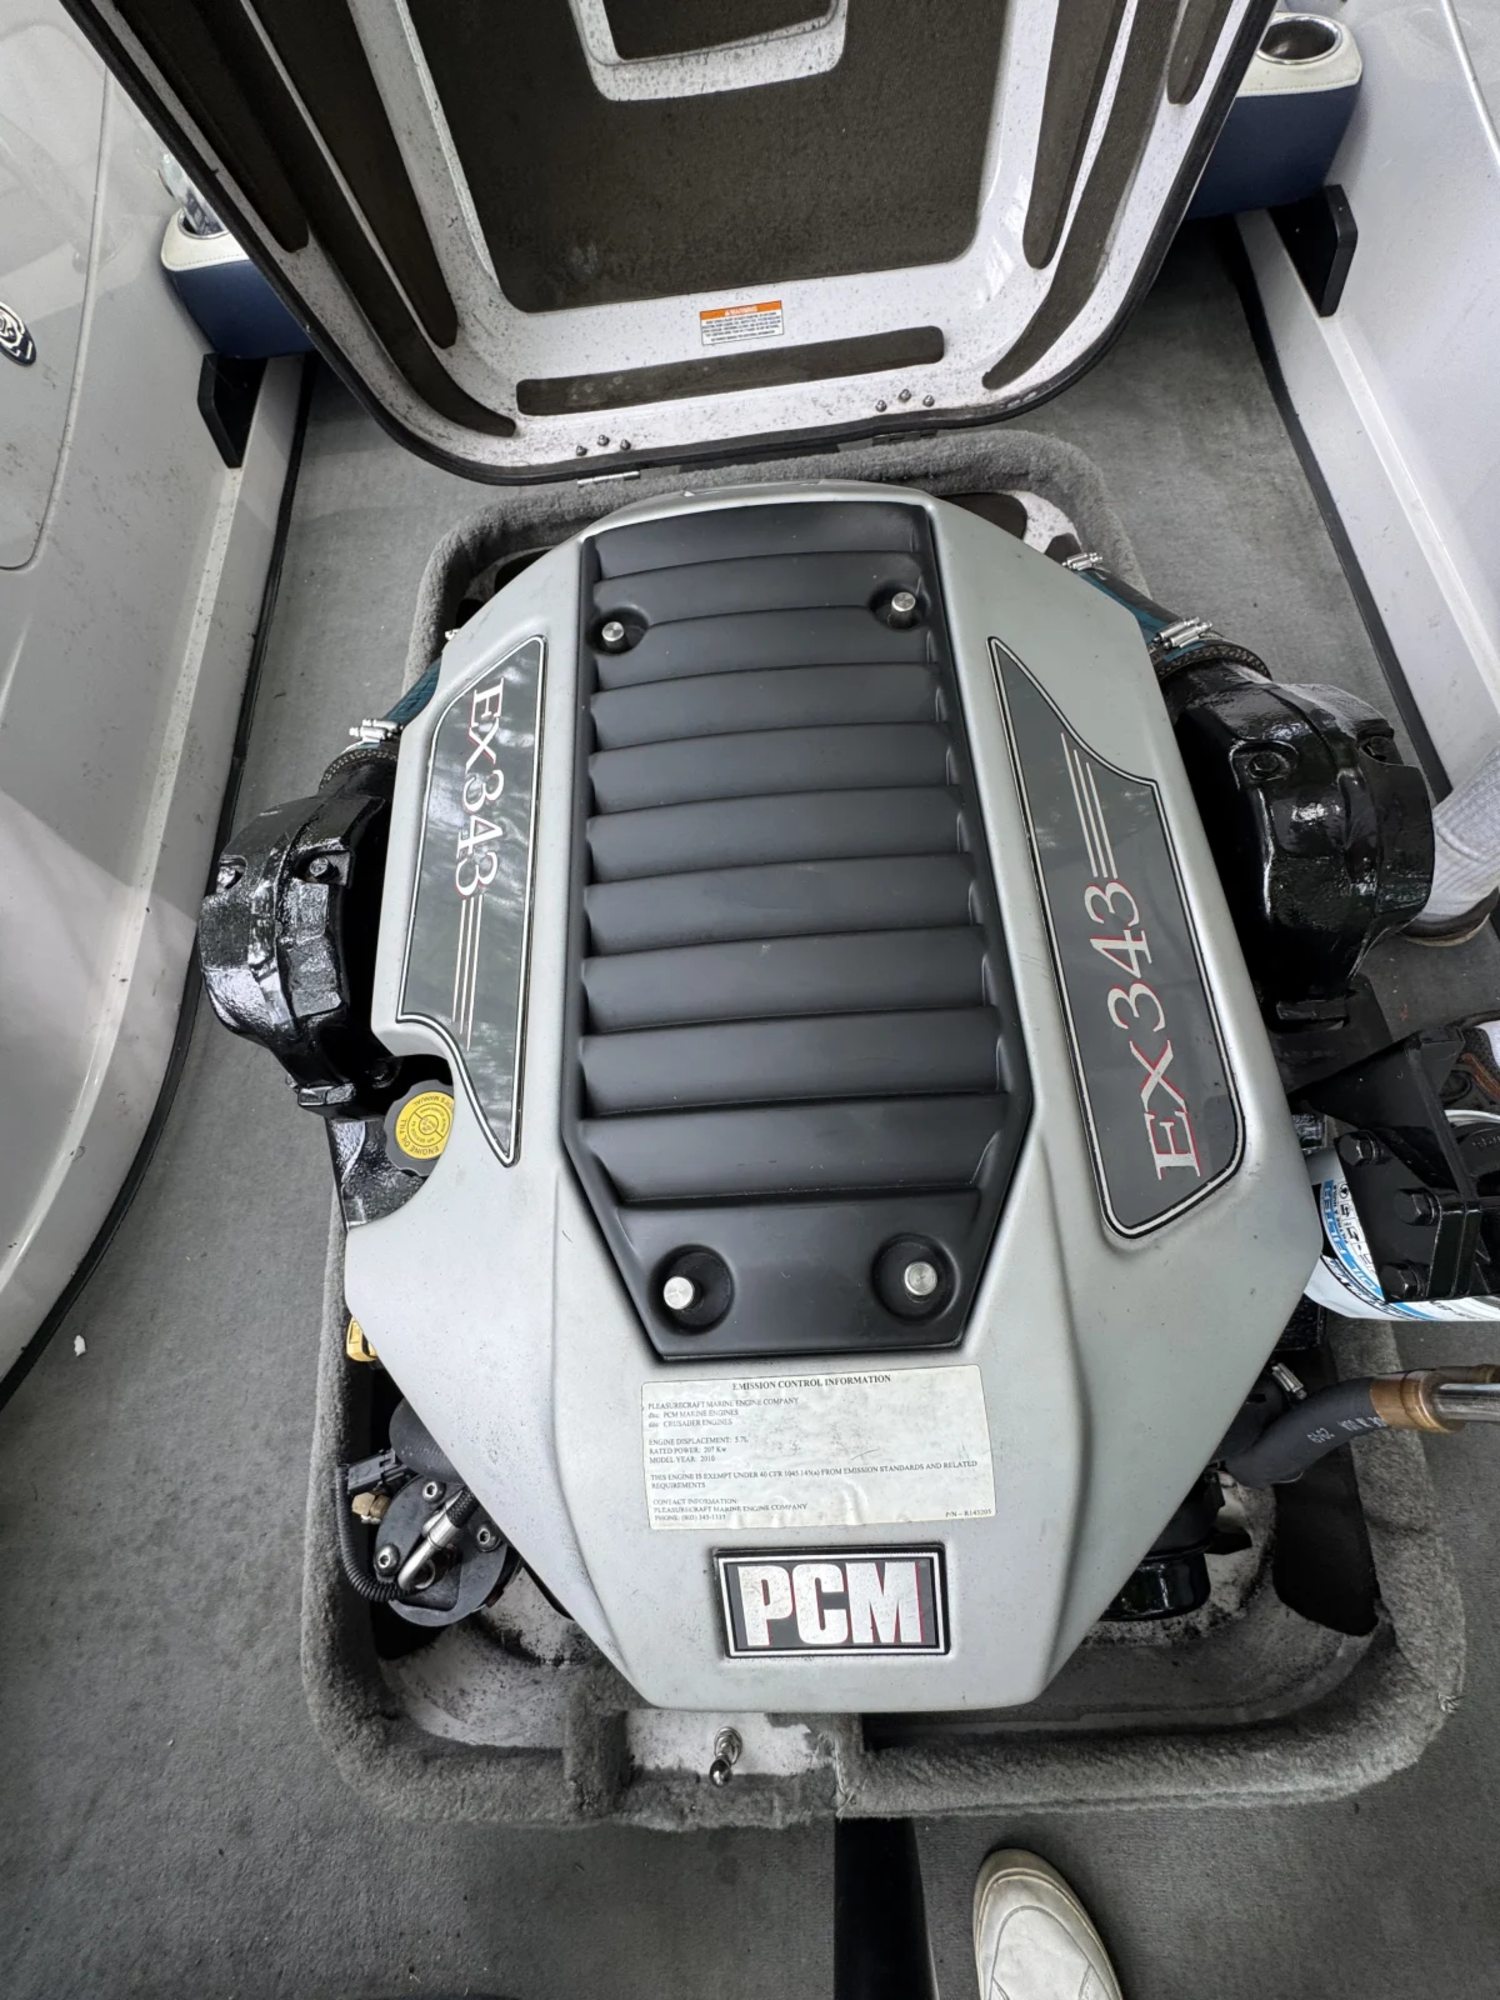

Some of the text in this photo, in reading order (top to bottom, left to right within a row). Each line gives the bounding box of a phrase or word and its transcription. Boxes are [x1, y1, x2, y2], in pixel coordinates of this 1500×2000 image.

[455, 677, 505, 897] EX343
[1084, 880, 1202, 1180] EX343
[410, 1145, 440, 1156] ENGINE
[1323, 1187, 1376, 1289] OIL FILTER
[732, 1374, 891, 1391] EMISSION CONTROL INFORMATION
[648, 1397, 799, 1410] PLEASURECRAFT MARINE ENGINE COMPANY
[663, 1411, 678, 1419] PCM
[679, 1410, 707, 1418] MARINE
[708, 1409, 739, 1417] ENGINES
[663, 1420, 701, 1428] CRUSADER
[702, 1418, 733, 1426] ENGINES
[649, 1438, 675, 1446] ENGINE
[649, 1447, 673, 1455] RATED
[649, 1456, 675, 1464] MODEL
[650, 1473, 667, 1481] THIS
[668, 1473, 694, 1481] ENGINE
[703, 1472, 732, 1480] EXEMPT
[733, 1471, 758, 1479] UNDER
[769, 1470, 782, 1478] CFR
[821, 1467, 842, 1476] FROM
[843, 1466, 878, 1475] EMISSION
[879, 1464, 925, 1473] STANDARDS
[925, 1463, 942, 1471] AND
[943, 1460, 977, 1469] RELATED
[651, 1482, 706, 1491] REQUIREMENTS
[653, 1498, 687, 1506] CONTACT
[654, 1503, 808, 1514] PLEASURECRAFT MARINE ENGINE COMPANY
[738, 1561, 926, 1647] PCM
